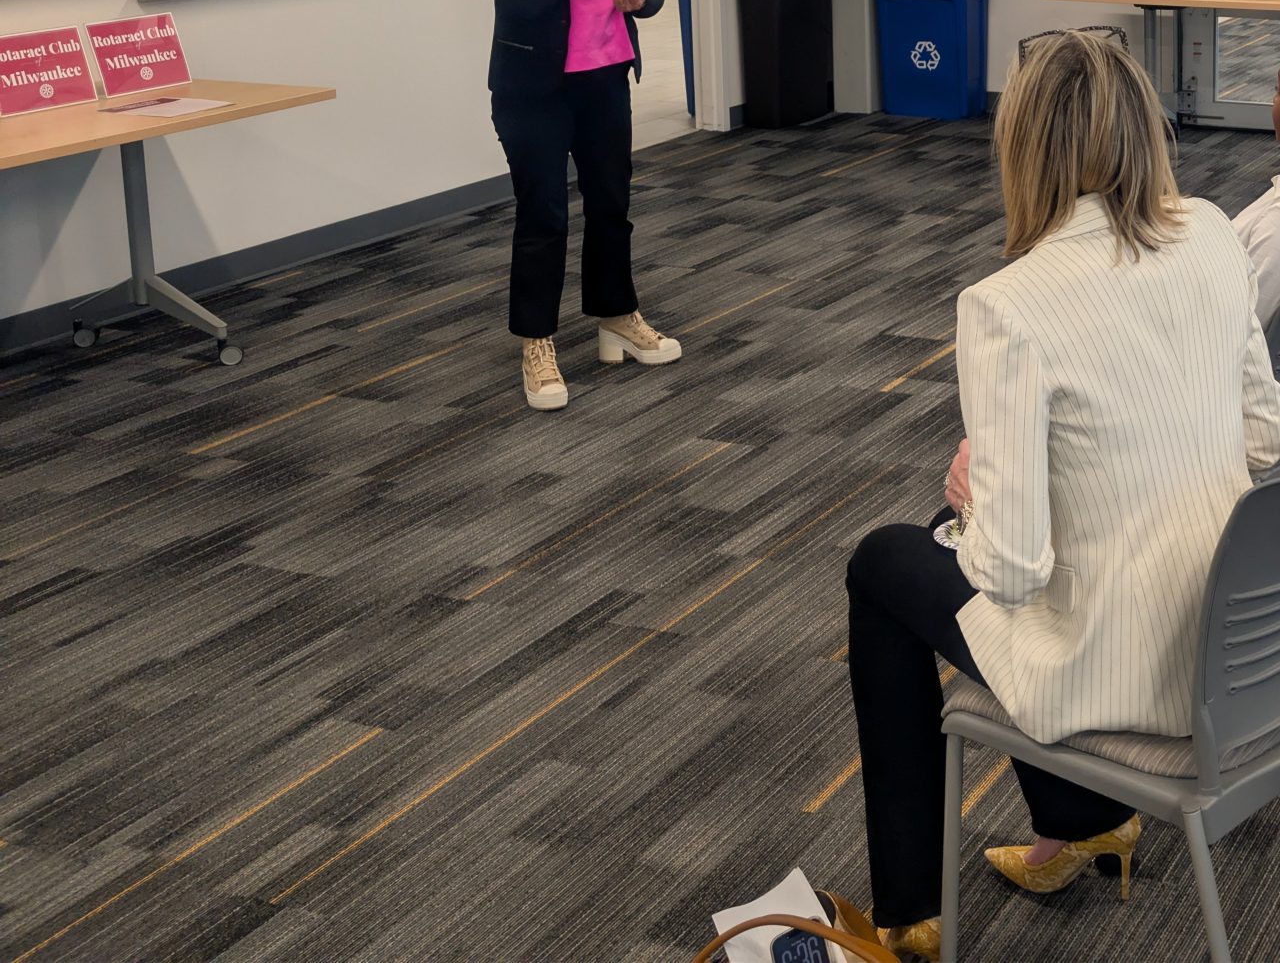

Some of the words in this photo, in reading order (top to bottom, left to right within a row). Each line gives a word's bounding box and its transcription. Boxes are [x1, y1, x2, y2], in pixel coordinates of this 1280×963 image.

[92, 29, 145, 48] Rotaract
[147, 24, 175, 39] Club
[0, 45, 47, 62] otaract
[48, 39, 81, 54] Club
[105, 49, 177, 71] Milwaukee
[1, 65, 82, 88] Milwaukee
